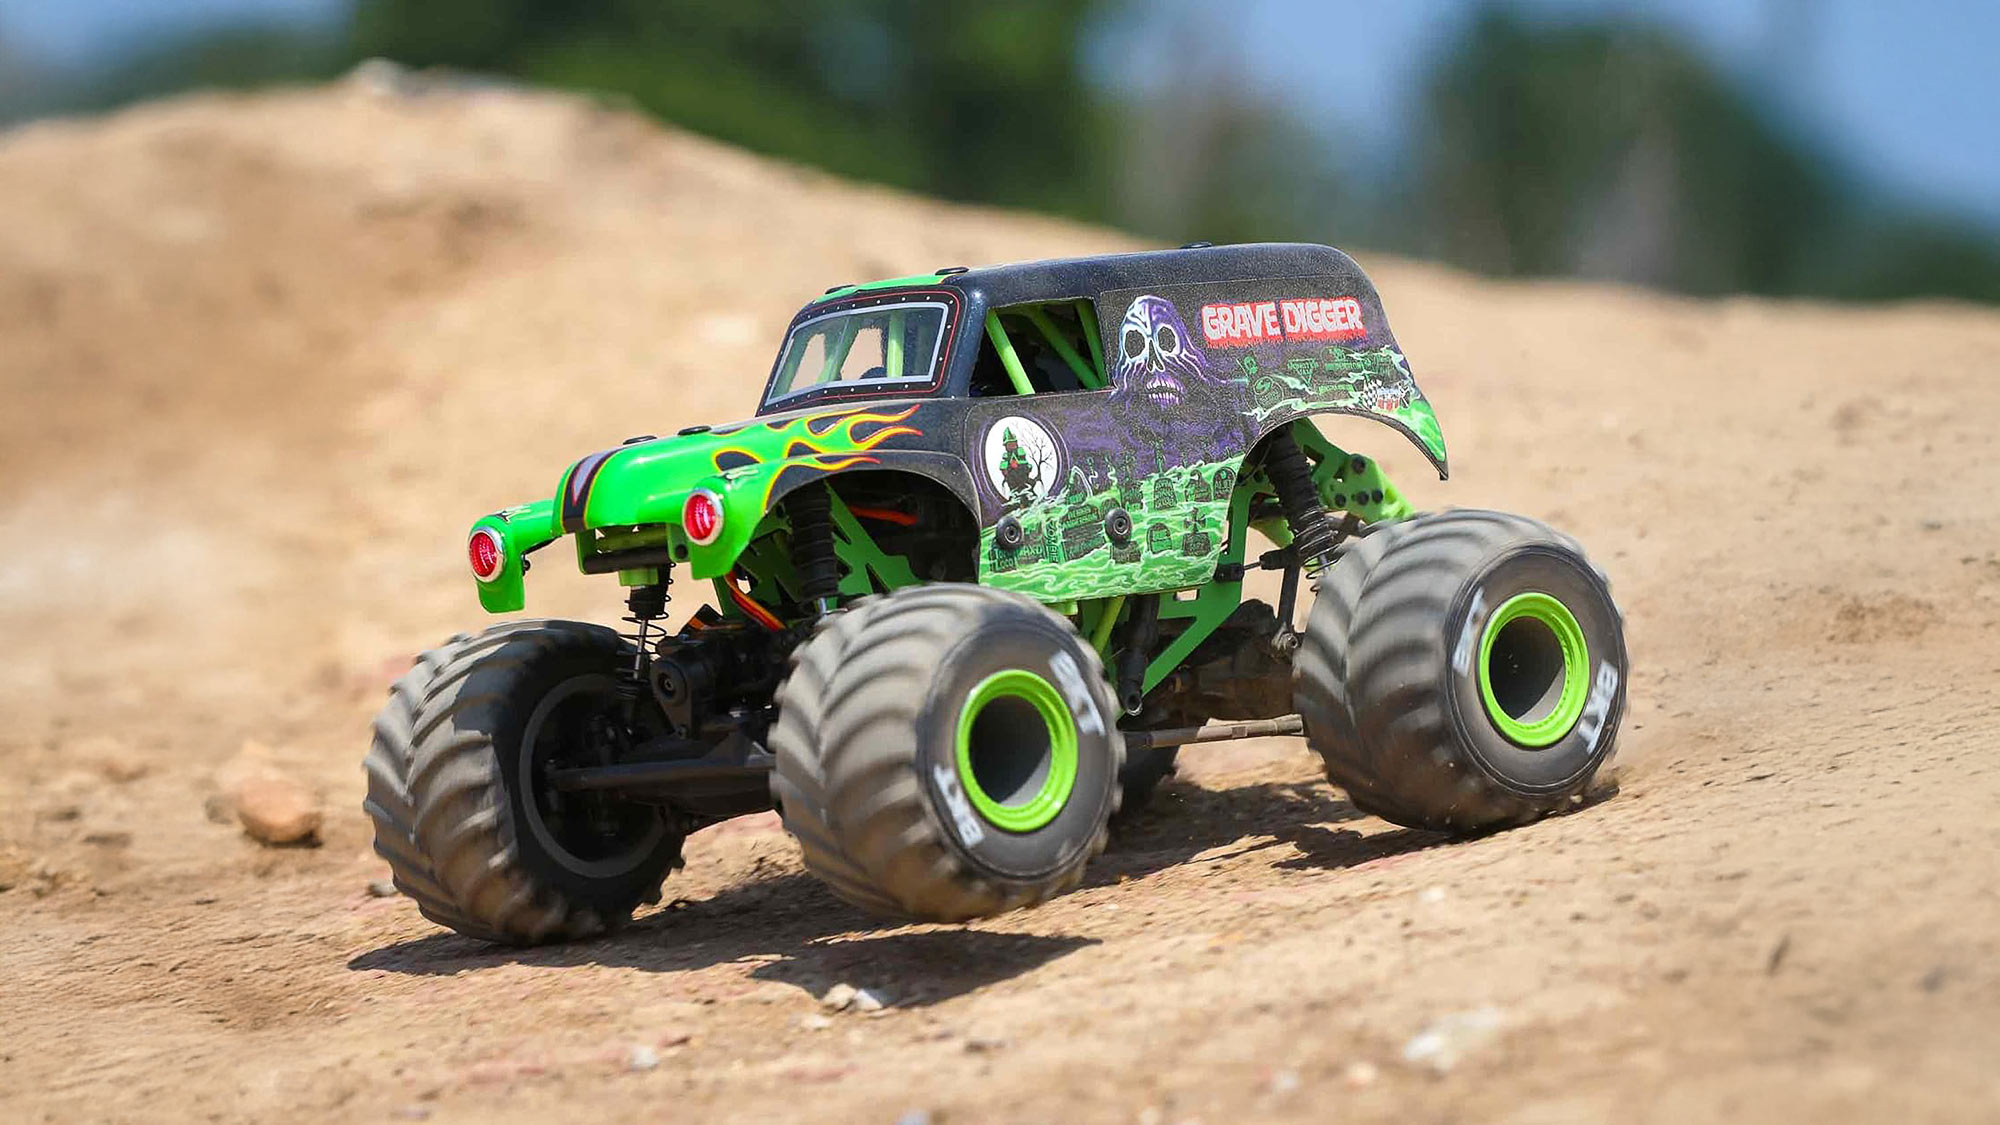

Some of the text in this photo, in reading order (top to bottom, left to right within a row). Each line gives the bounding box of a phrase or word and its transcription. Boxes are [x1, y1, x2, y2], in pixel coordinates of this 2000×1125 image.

[1202, 299, 1363, 340] GRAVE DIGGER
[1453, 586, 1487, 678] BKT
[1050, 649, 1105, 736] BKT
[1578, 659, 1618, 755] BKT
[933, 763, 986, 847] BKT
